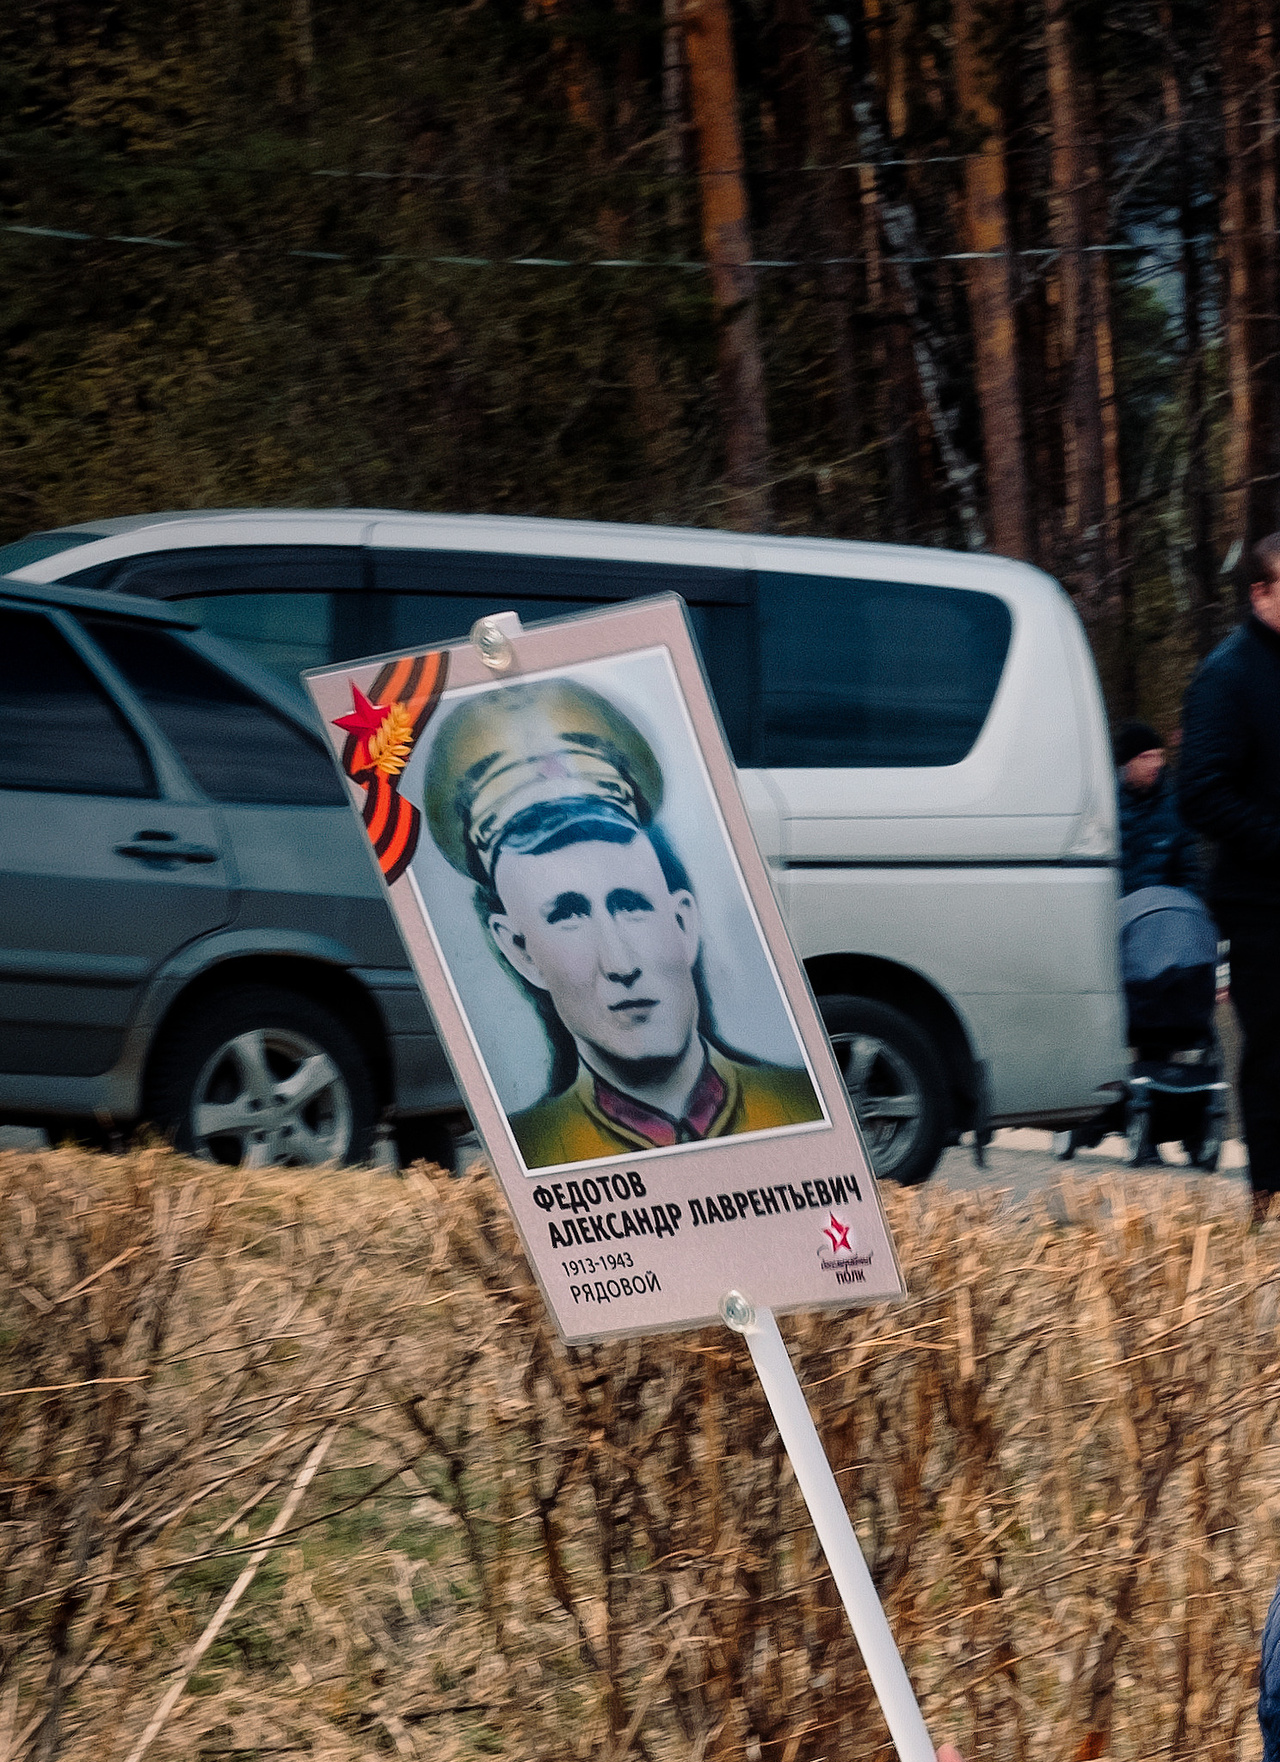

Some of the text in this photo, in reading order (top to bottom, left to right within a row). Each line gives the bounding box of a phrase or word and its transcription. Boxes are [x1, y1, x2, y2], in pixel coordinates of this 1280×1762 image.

[533, 1171, 647, 1214] ФЕДОТОВ
[548, 1174, 863, 1249] АЛЕКСАНДР ЛАВРЕНТЬЕВИЧ
[561, 1252, 634, 1277] 1913-1943
[569, 1270, 662, 1304] РЯДОВОЙ
